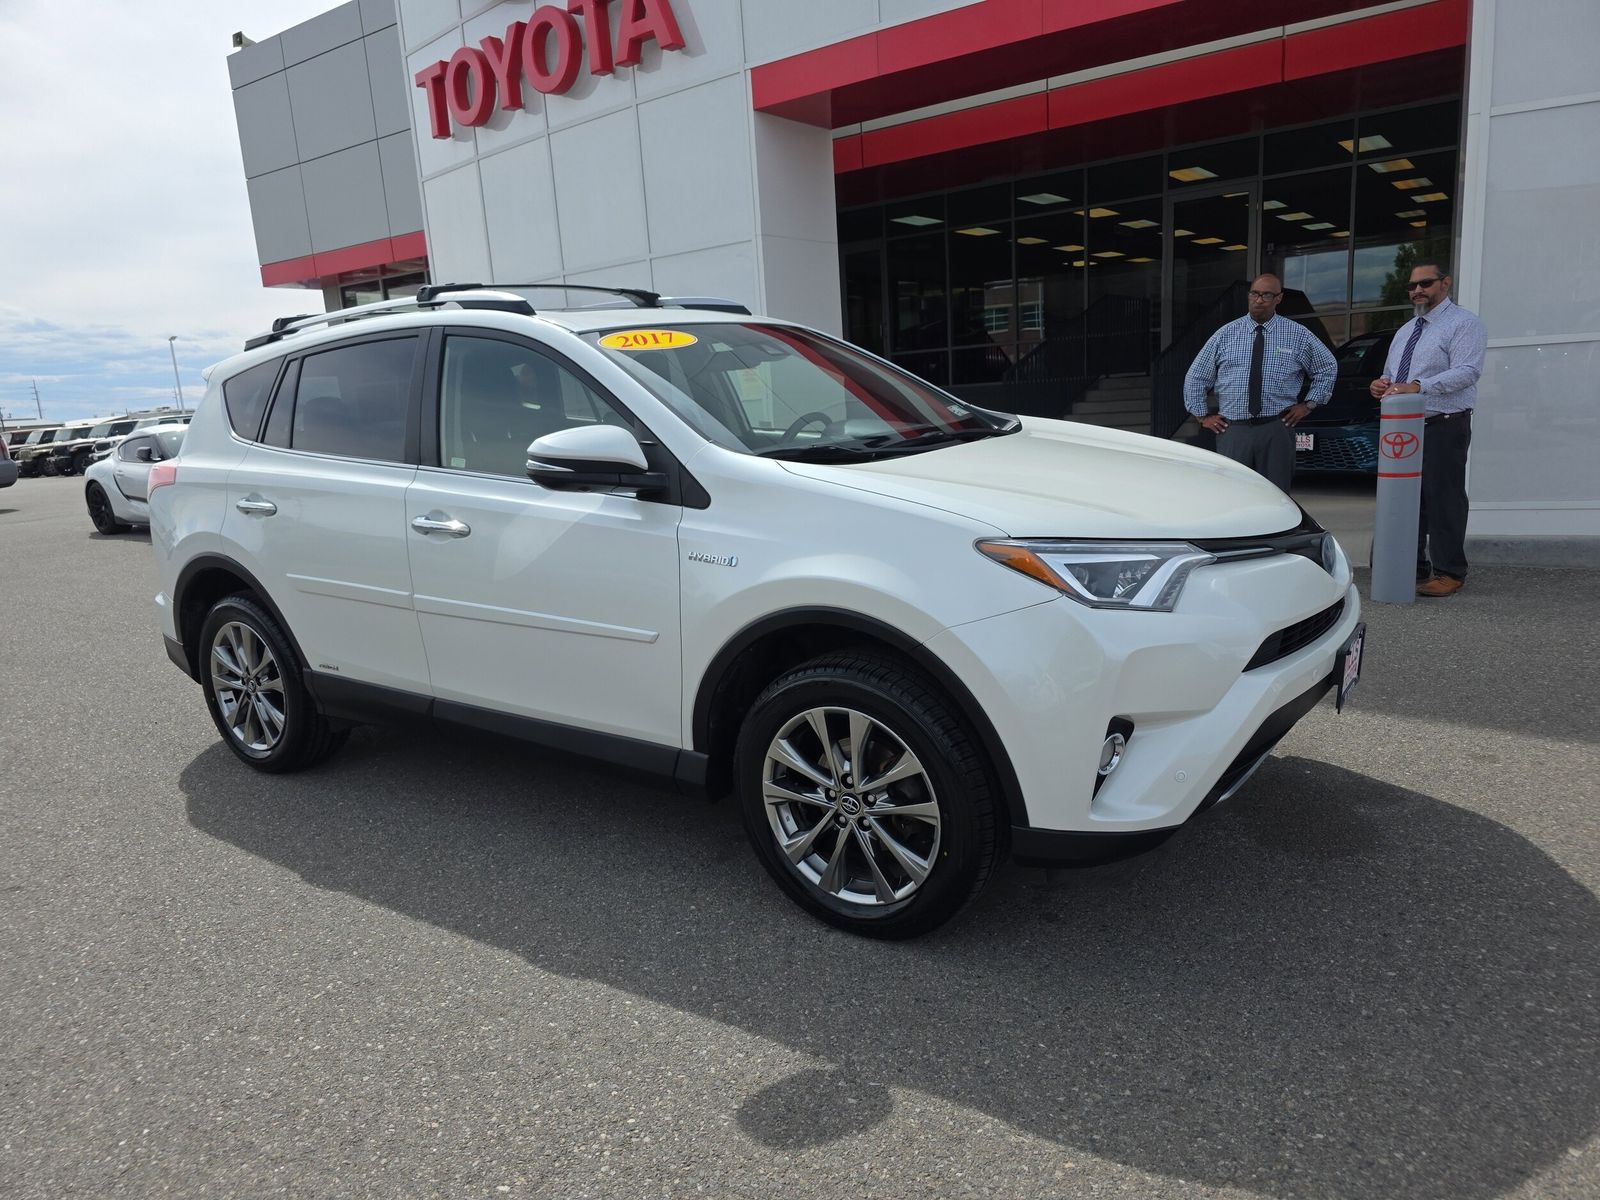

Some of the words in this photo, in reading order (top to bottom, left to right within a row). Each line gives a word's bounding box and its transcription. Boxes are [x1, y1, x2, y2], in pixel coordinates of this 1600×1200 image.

[415, 0, 686, 140] TOYOTA
[617, 331, 673, 348] 2017
[688, 551, 729, 567] HYBRID
